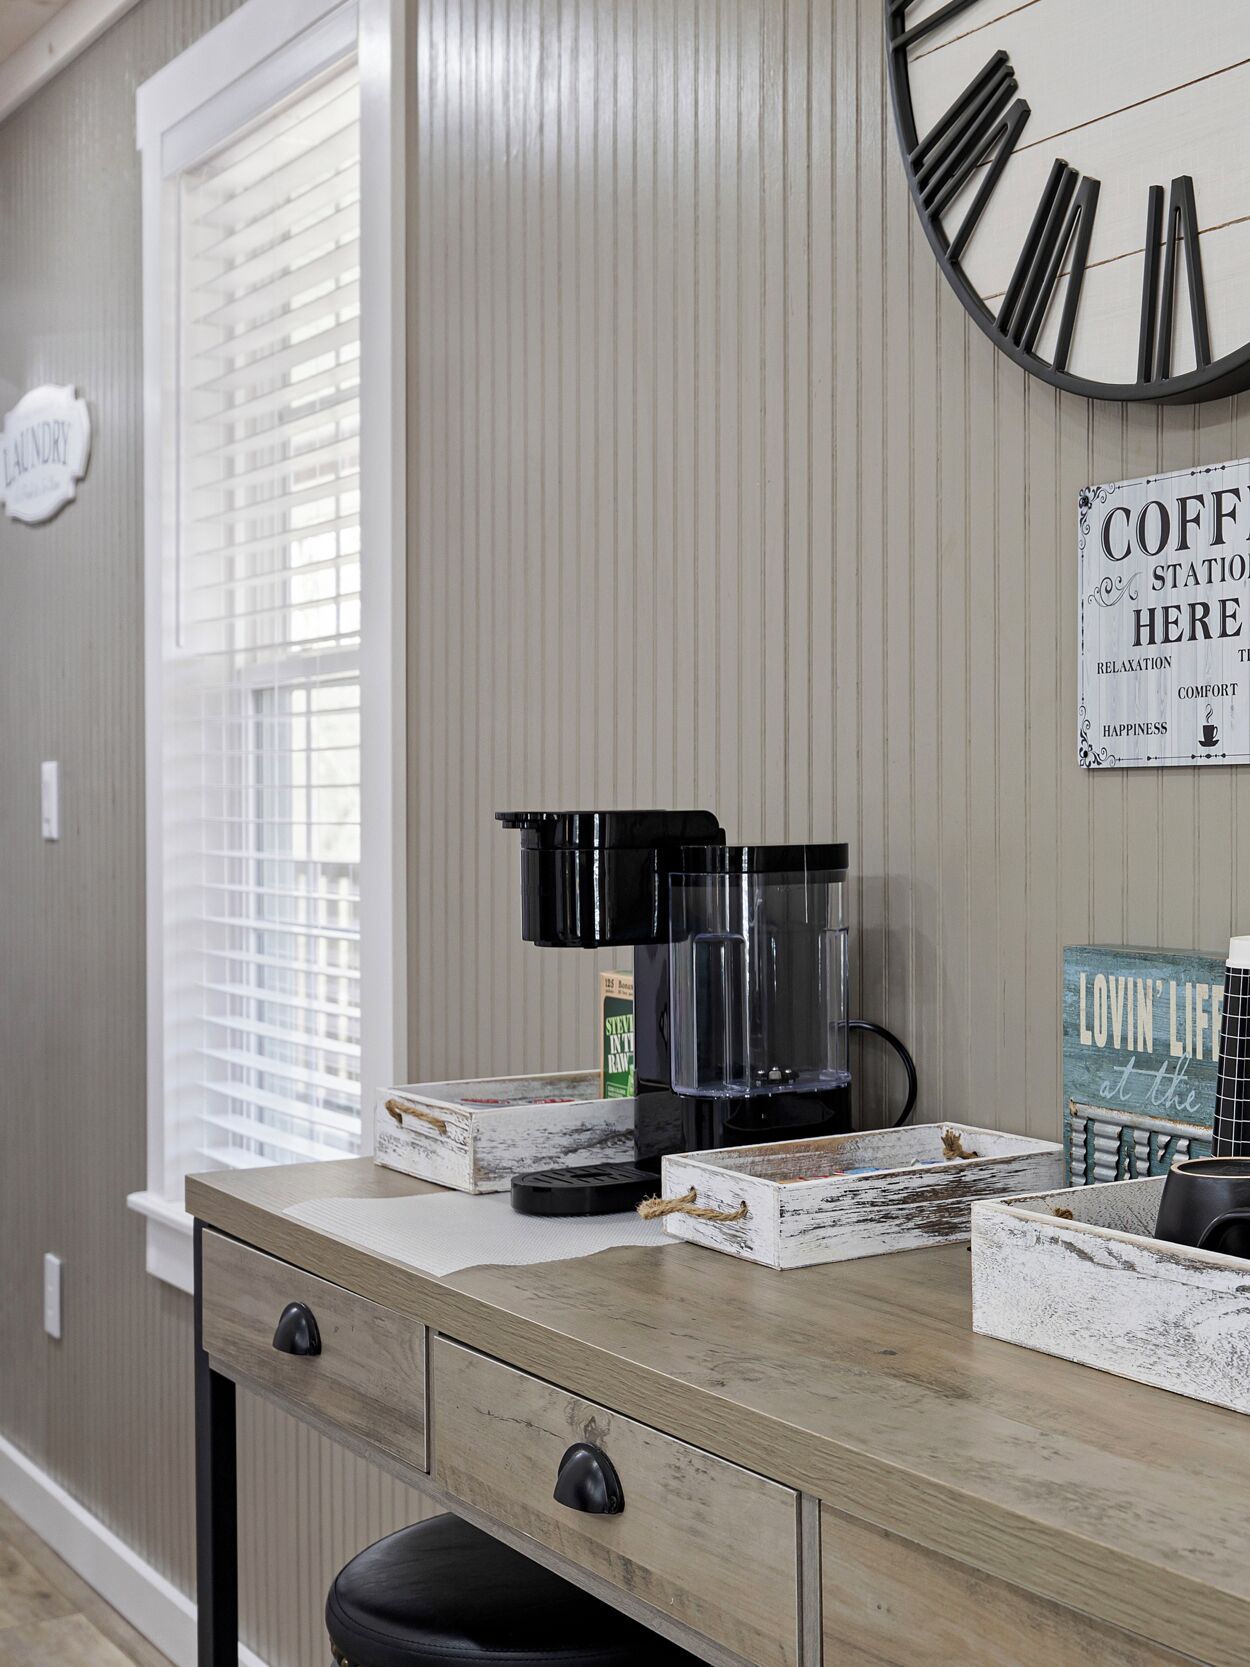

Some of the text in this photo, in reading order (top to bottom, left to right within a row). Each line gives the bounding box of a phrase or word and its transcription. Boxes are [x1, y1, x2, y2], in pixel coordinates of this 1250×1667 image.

[3, 420, 72, 488] LAUNDRY
[1132, 597, 1243, 647] HERE
[1096, 655, 1172, 675] RELAXATION
[1177, 682, 1239, 700] COMFORT
[1102, 721, 1168, 738] HAPPINESS
[609, 1034, 621, 1054] IN
[608, 1053, 629, 1074] RAW
[1099, 1051, 1202, 1113] at the
